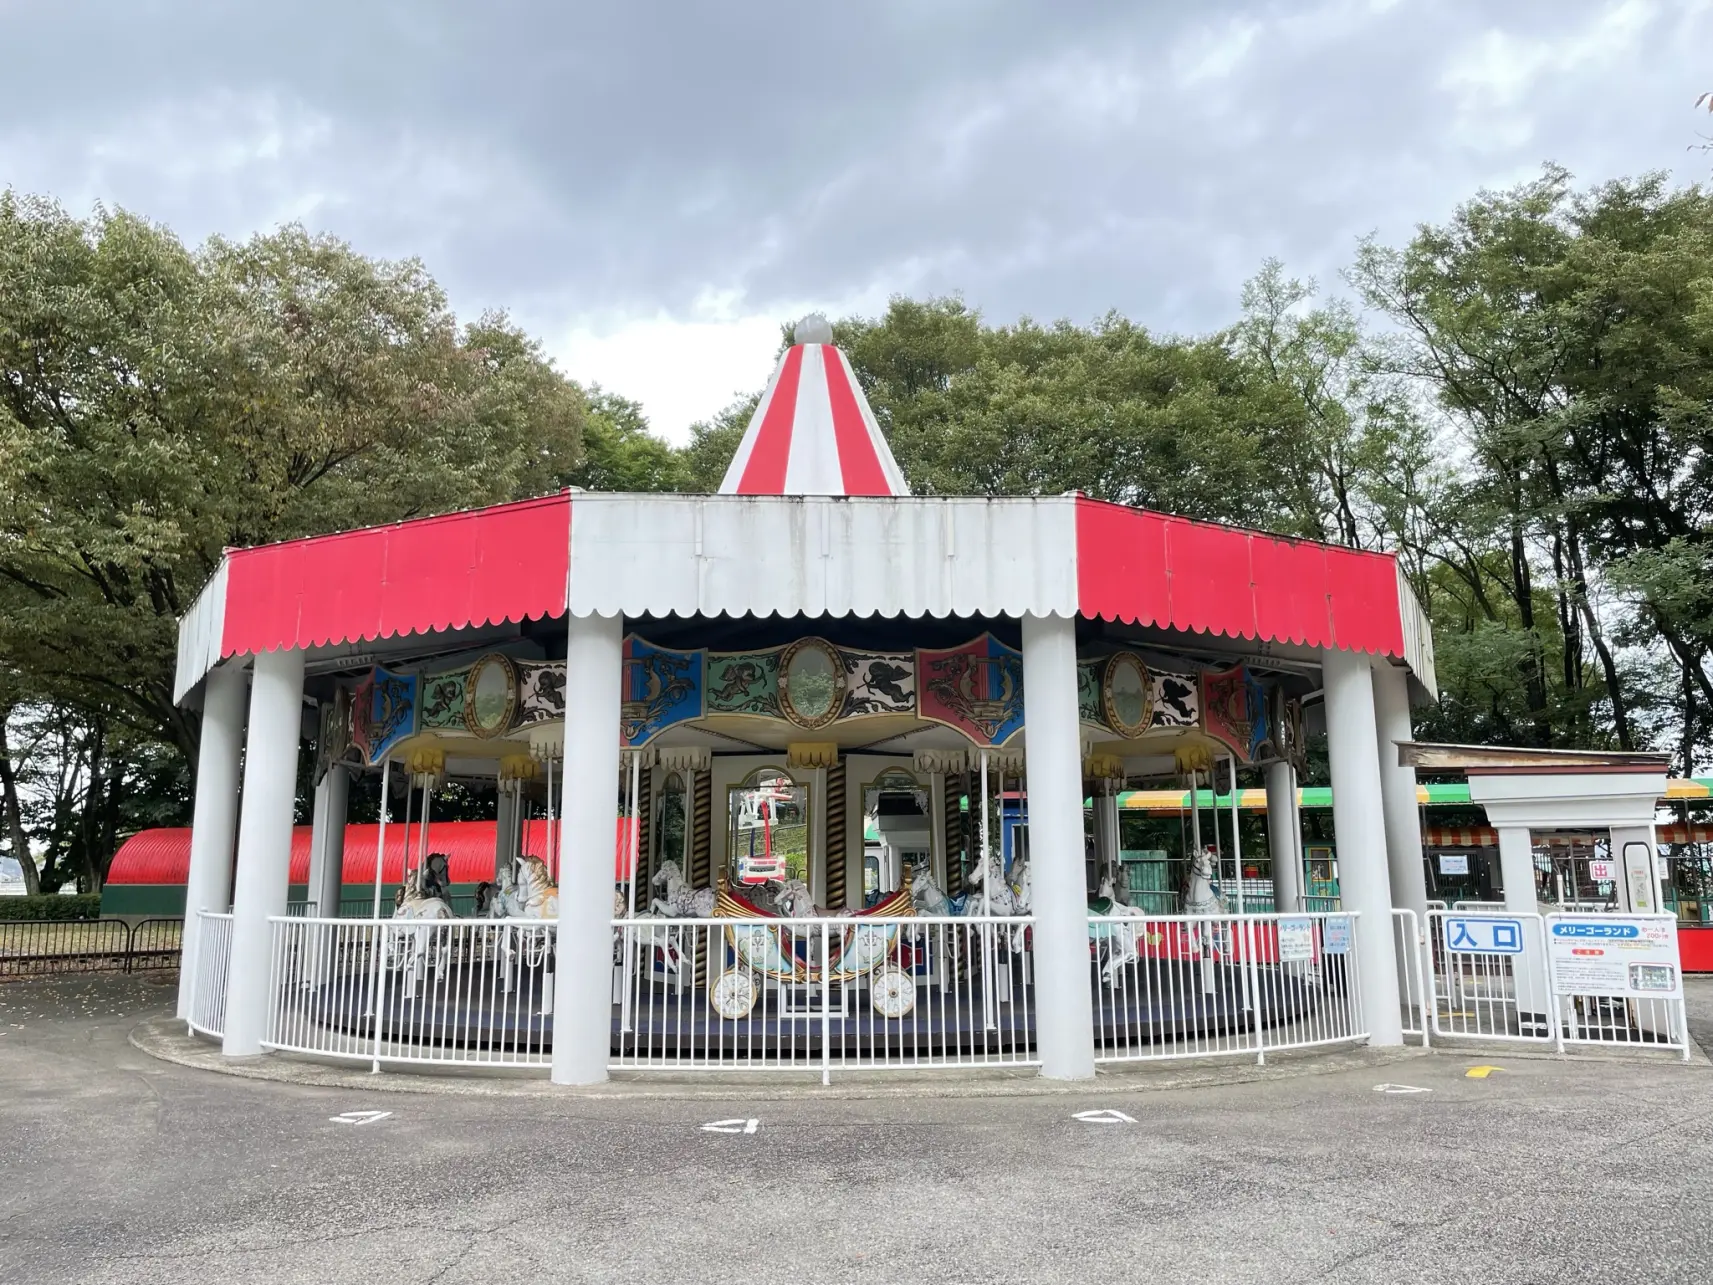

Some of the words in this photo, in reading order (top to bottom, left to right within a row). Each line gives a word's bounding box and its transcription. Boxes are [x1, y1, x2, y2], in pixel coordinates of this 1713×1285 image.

[1452, 923, 1517, 948] 入口
[1559, 926, 1631, 936] メリーゴーランド
